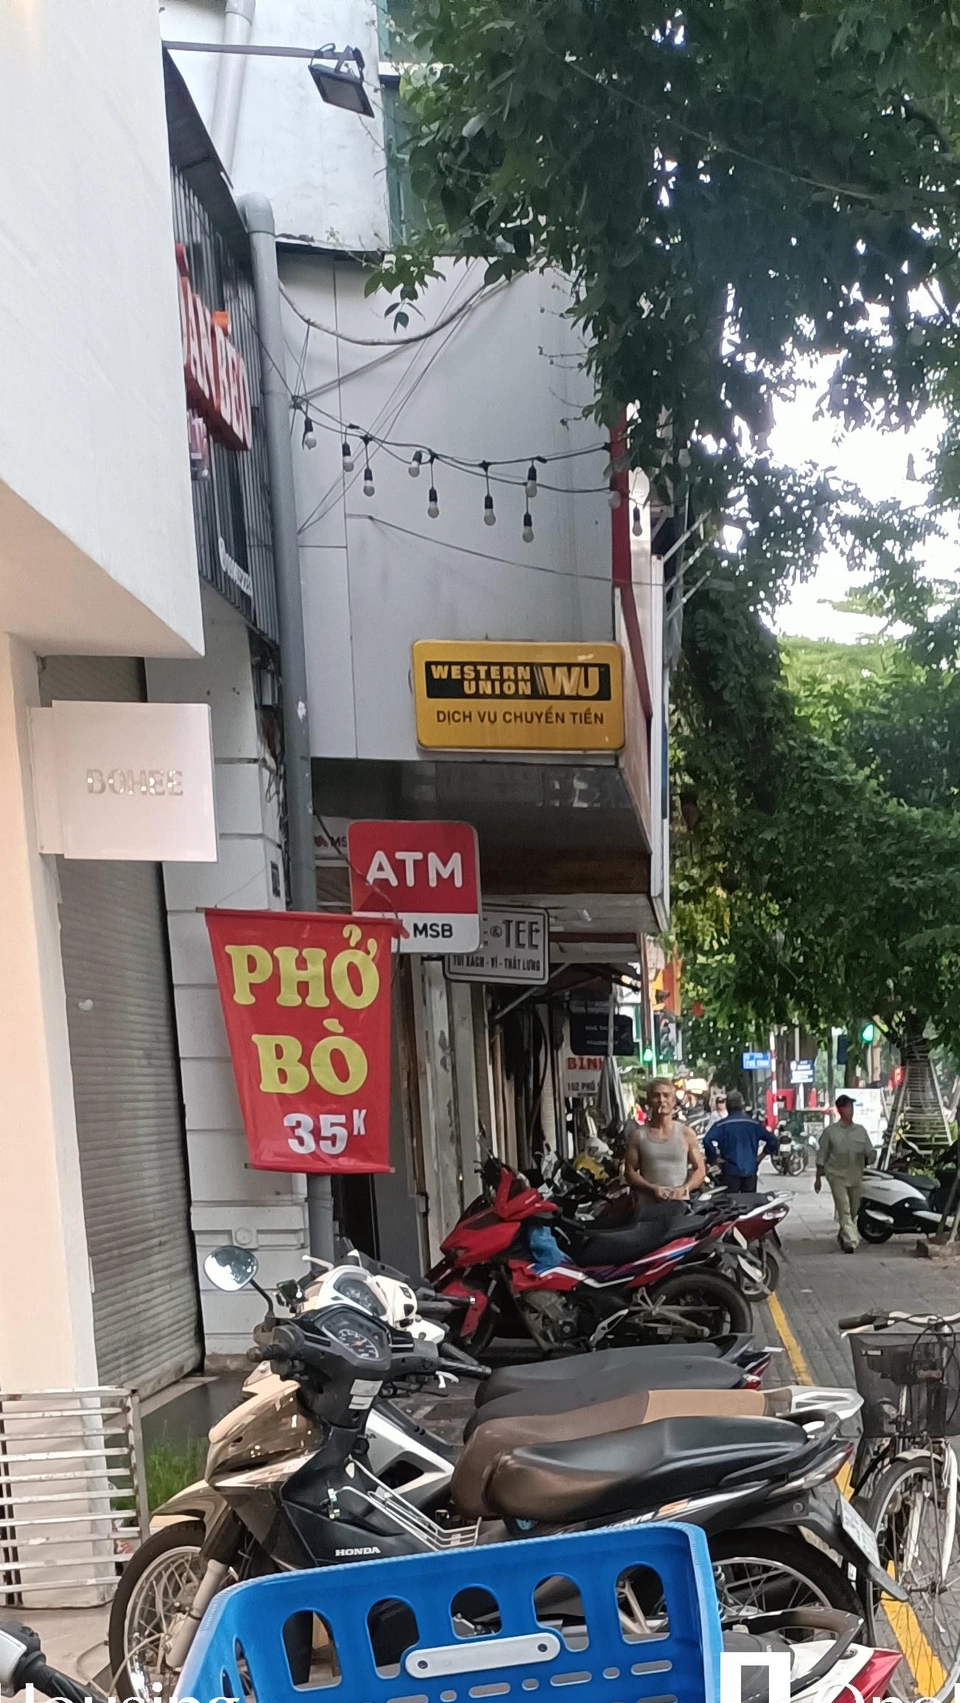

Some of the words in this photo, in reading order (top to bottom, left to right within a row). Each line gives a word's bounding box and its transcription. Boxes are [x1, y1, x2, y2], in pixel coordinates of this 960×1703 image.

[431, 665, 531, 680] WESTERN
[543, 666, 600, 697] WU
[463, 680, 532, 695] UNION
[436, 710, 473, 726] DỊCH
[477, 710, 498, 725] VỤ
[502, 705, 566, 725] CHUYỂN
[86, 769, 184, 796] BOHEE
[366, 850, 463, 888] ATM
[412, 922, 454, 939] MSB
[502, 919, 540, 950] TEE
[225, 924, 380, 1010] PHỞ
[252, 1018, 369, 1096] BÒ
[335, 1546, 381, 1557] HONDA
